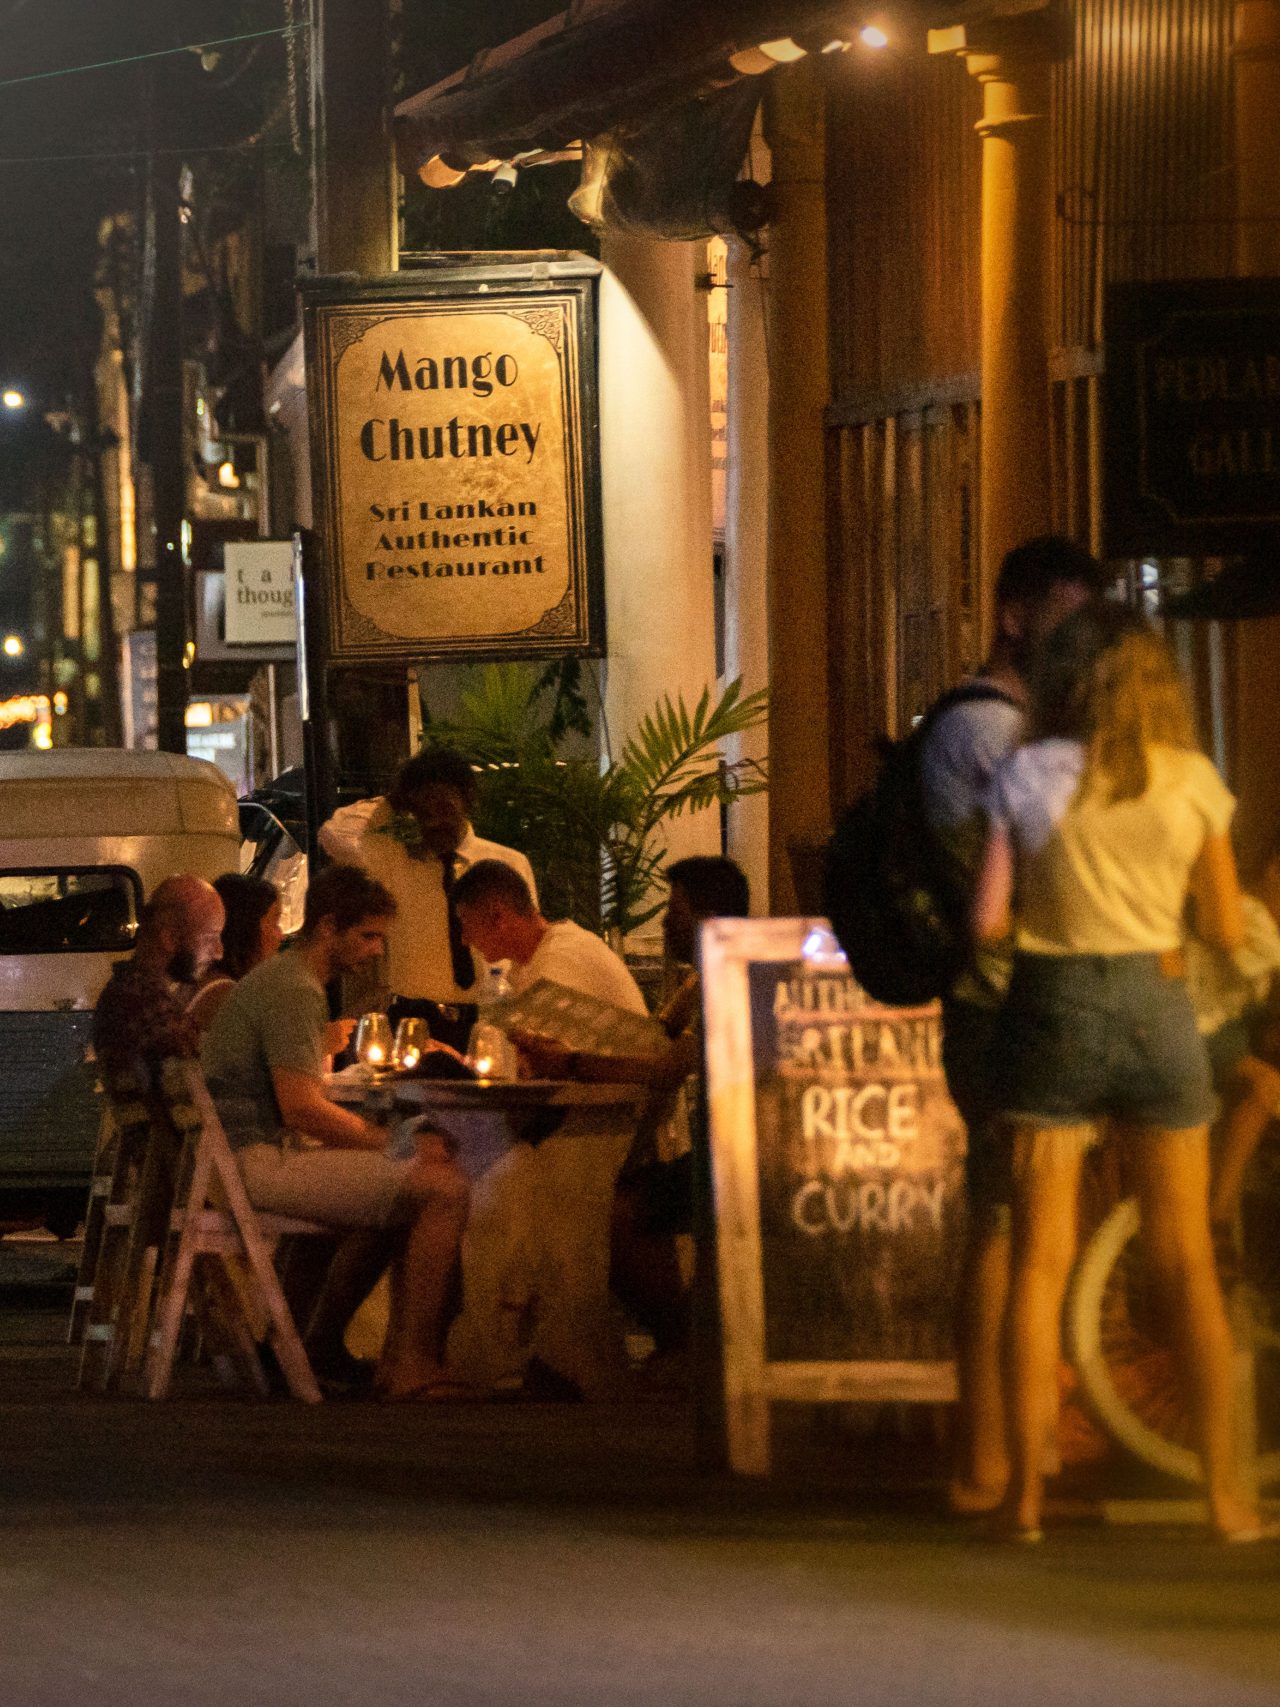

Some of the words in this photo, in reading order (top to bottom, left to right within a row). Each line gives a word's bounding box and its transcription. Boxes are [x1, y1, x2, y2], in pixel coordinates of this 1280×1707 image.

[375, 349, 519, 398] Mango
[360, 418, 542, 464] Chutney
[370, 501, 409, 523] Sri
[420, 500, 538, 521] Lankan
[374, 526, 535, 551] Authentic
[365, 554, 548, 581] Restaurant
[237, 586, 293, 608] thoug
[802, 1083, 919, 1141] RICE
[792, 1180, 946, 1236] CURRY
